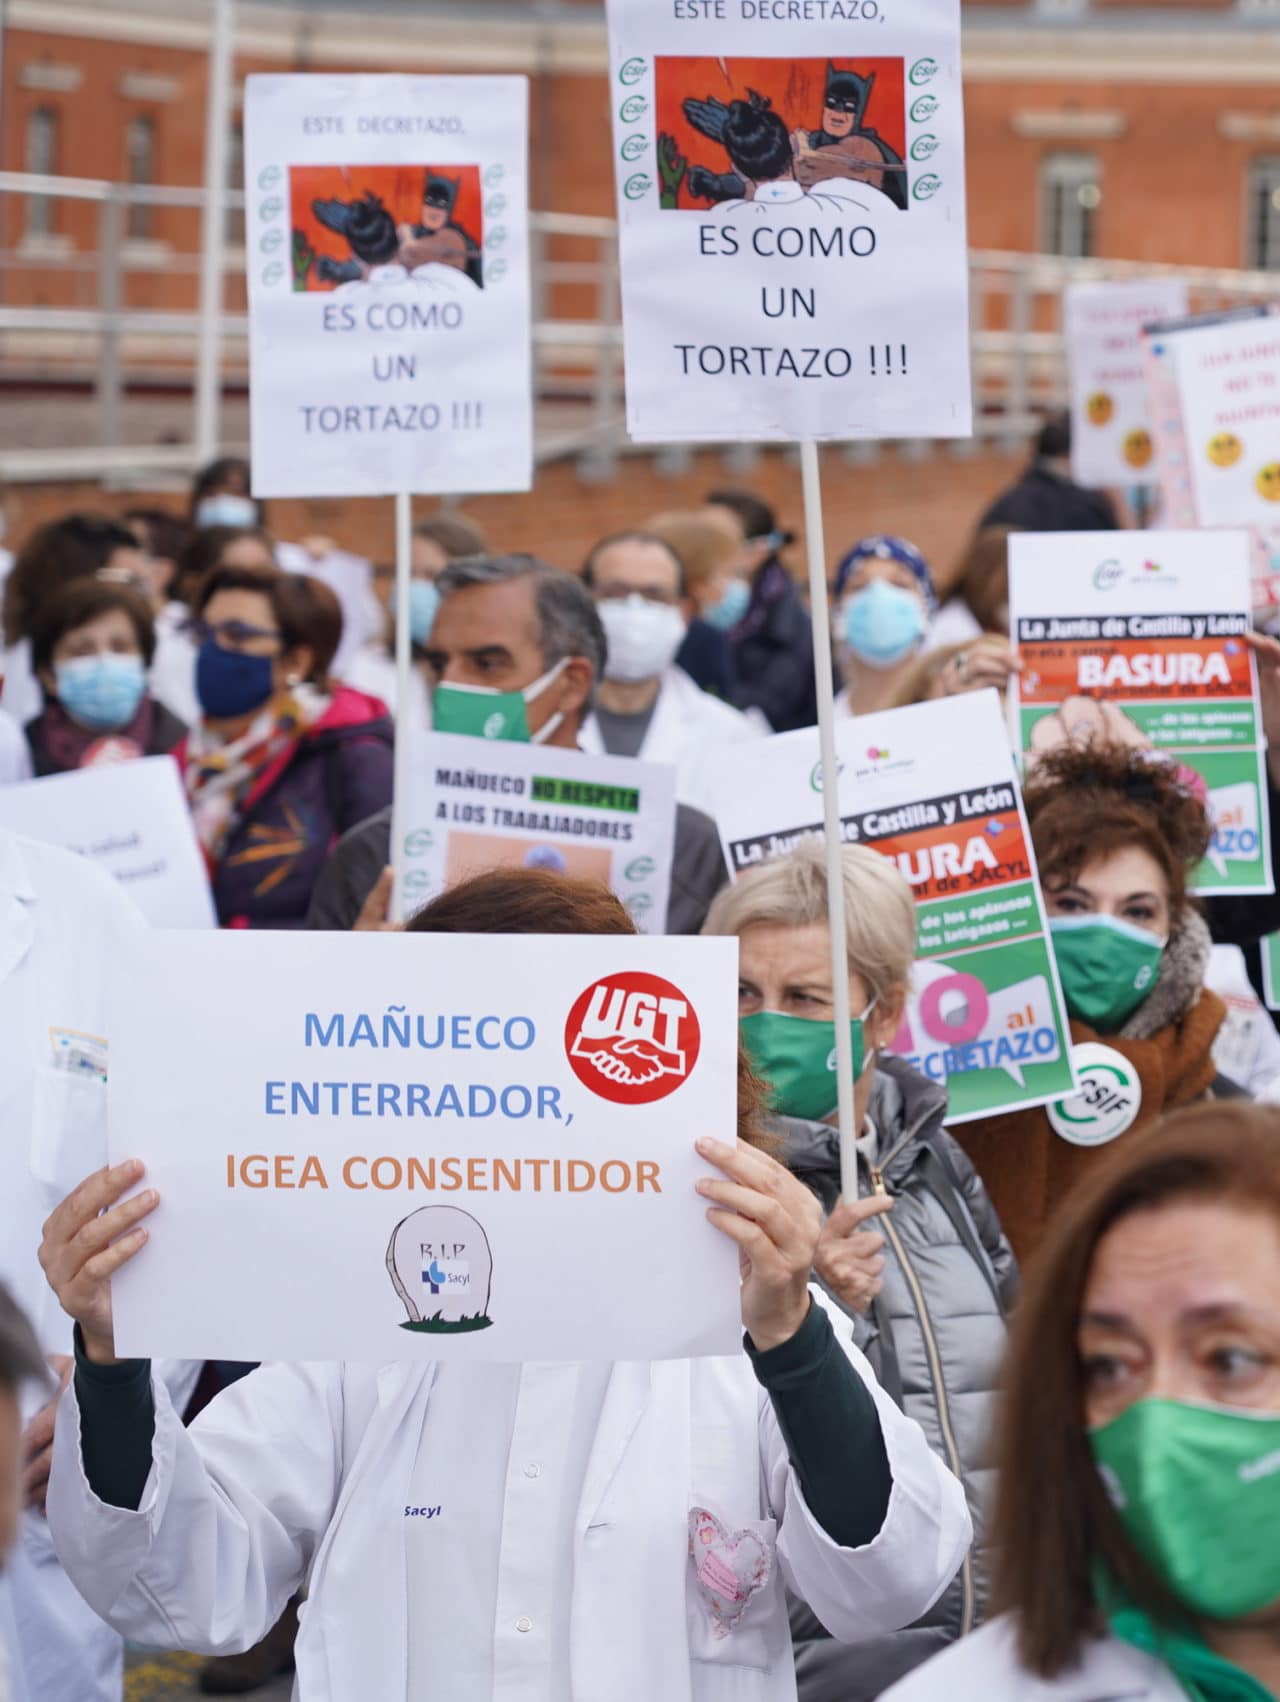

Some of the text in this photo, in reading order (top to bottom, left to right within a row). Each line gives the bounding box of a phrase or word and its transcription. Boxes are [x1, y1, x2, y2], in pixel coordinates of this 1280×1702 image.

[674, 0, 886, 23] ESTE DECRETAZO,
[700, 225, 876, 258] ES COMO
[322, 302, 463, 332] ES COMO
[762, 287, 815, 318] UN
[372, 355, 417, 381] UN
[674, 344, 908, 379] TORTAZO !!!
[301, 402, 483, 434] TORTAZO !!!
[1021, 620, 1045, 639] La
[1047, 617, 1099, 639] Junta
[1102, 615, 1126, 637] de
[1129, 615, 1191, 637] Castilla
[1192, 618, 1206, 639] y
[1077, 652, 1232, 687] BASURA
[435, 767, 525, 796] MAÑUECO
[435, 801, 633, 841] A LOS TRABAJADORES
[736, 842, 763, 866] La
[862, 804, 939, 838] Castilla
[940, 801, 957, 825] y
[960, 785, 1013, 815] León
[882, 836, 998, 885] URA
[935, 878, 961, 893] de
[969, 861, 1030, 887] SACYL
[303, 1004, 537, 1051] MAÑUECO
[580, 985, 688, 1053] UGT
[1007, 1003, 1036, 1030] al
[907, 1027, 1057, 1080] ECRETAZO
[264, 1081, 575, 1127] ENTERRADOR,
[226, 1154, 663, 1194] IGEA CONSENTIDOR
[447, 1273, 470, 1287] Sacyl
[404, 1505, 442, 1519] Sacyl
